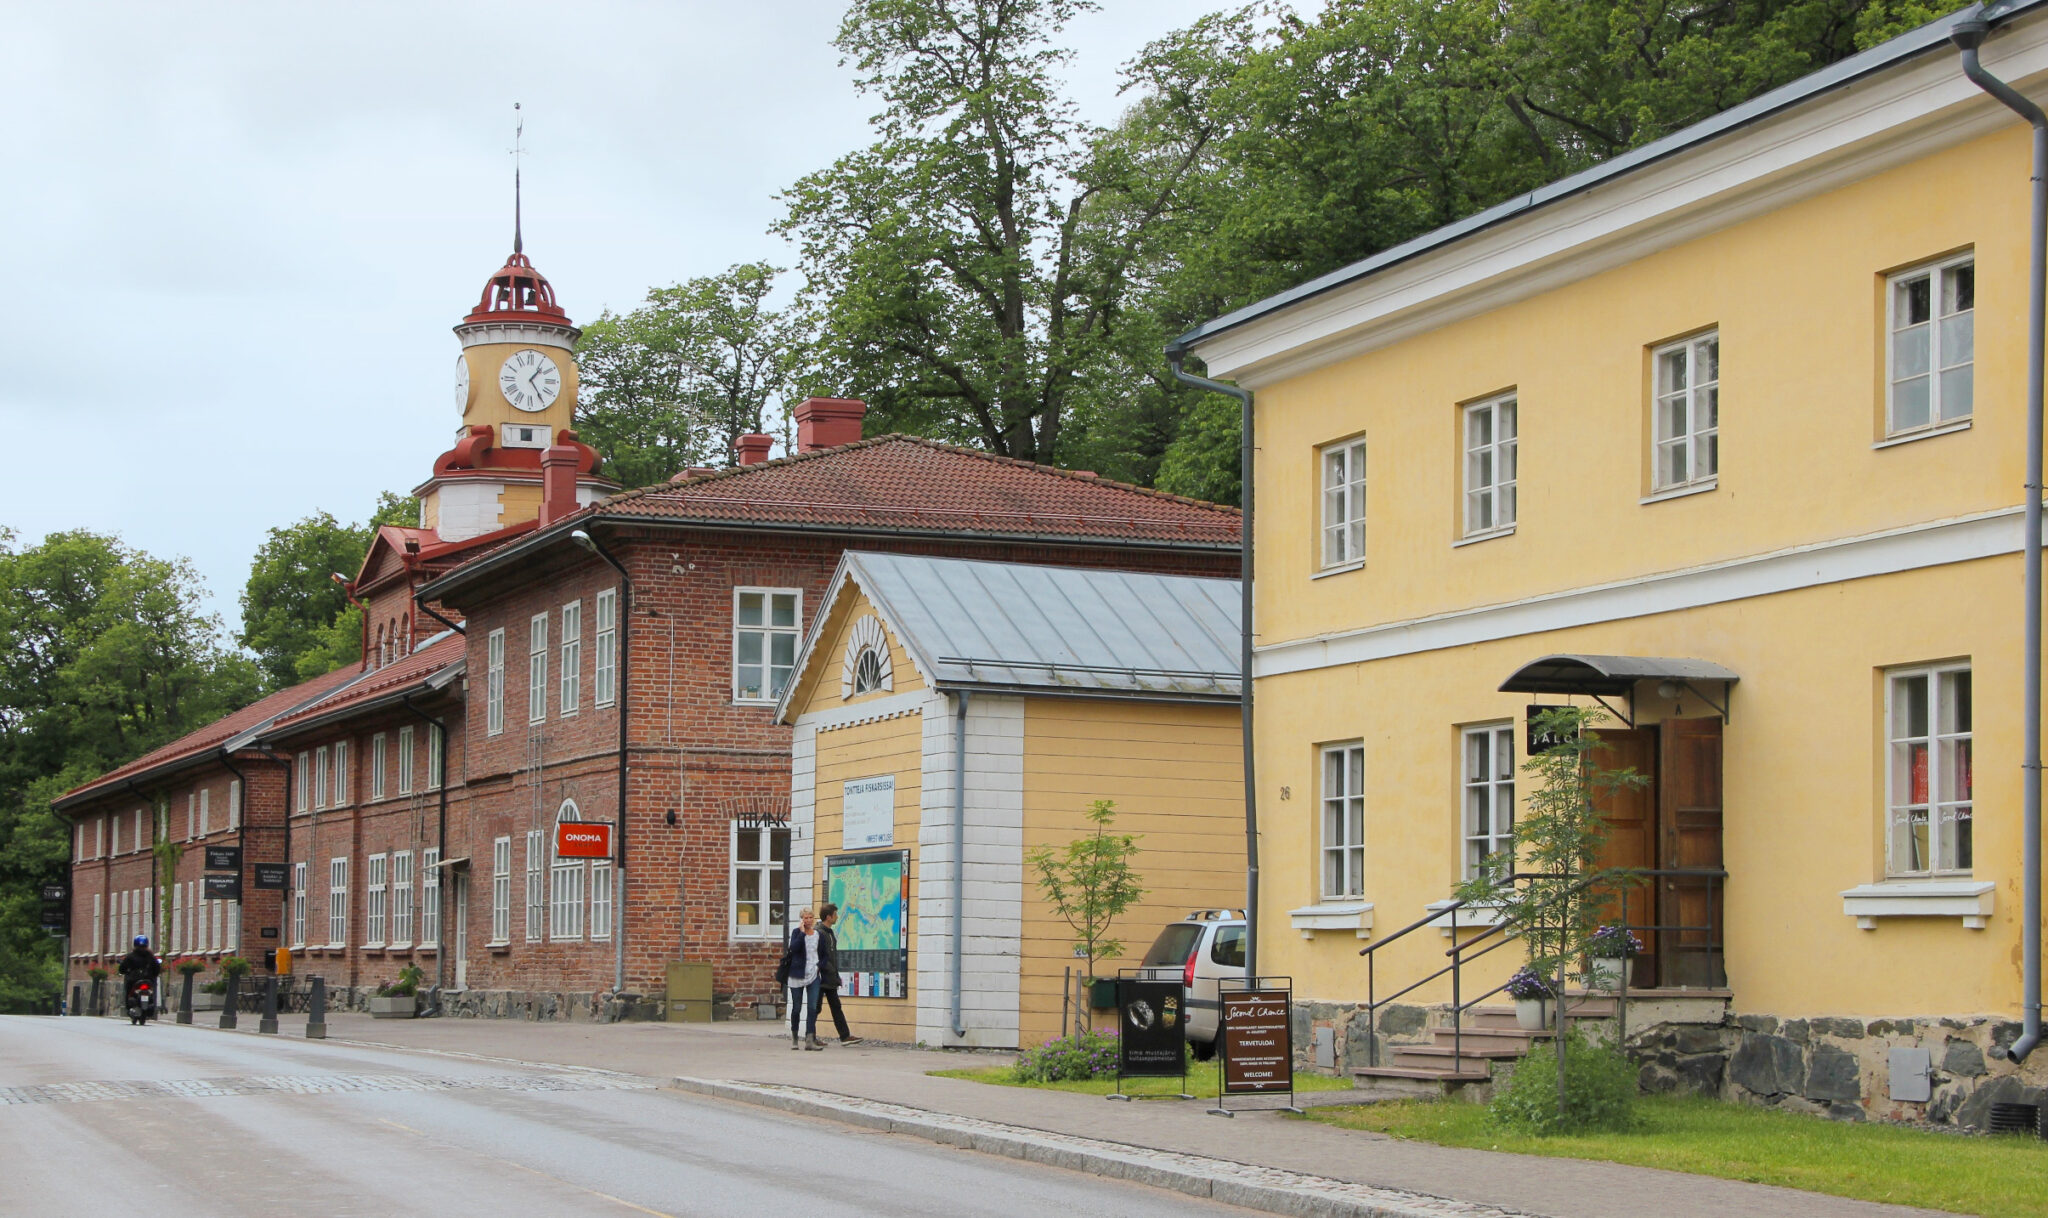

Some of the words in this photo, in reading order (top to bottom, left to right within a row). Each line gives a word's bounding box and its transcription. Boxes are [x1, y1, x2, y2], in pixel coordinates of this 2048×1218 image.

[1279, 785, 1291, 801] 26
[565, 833, 602, 842] ONOMA
[1225, 1006, 1255, 1021] Second
[1257, 1007, 1286, 1017] Chance
